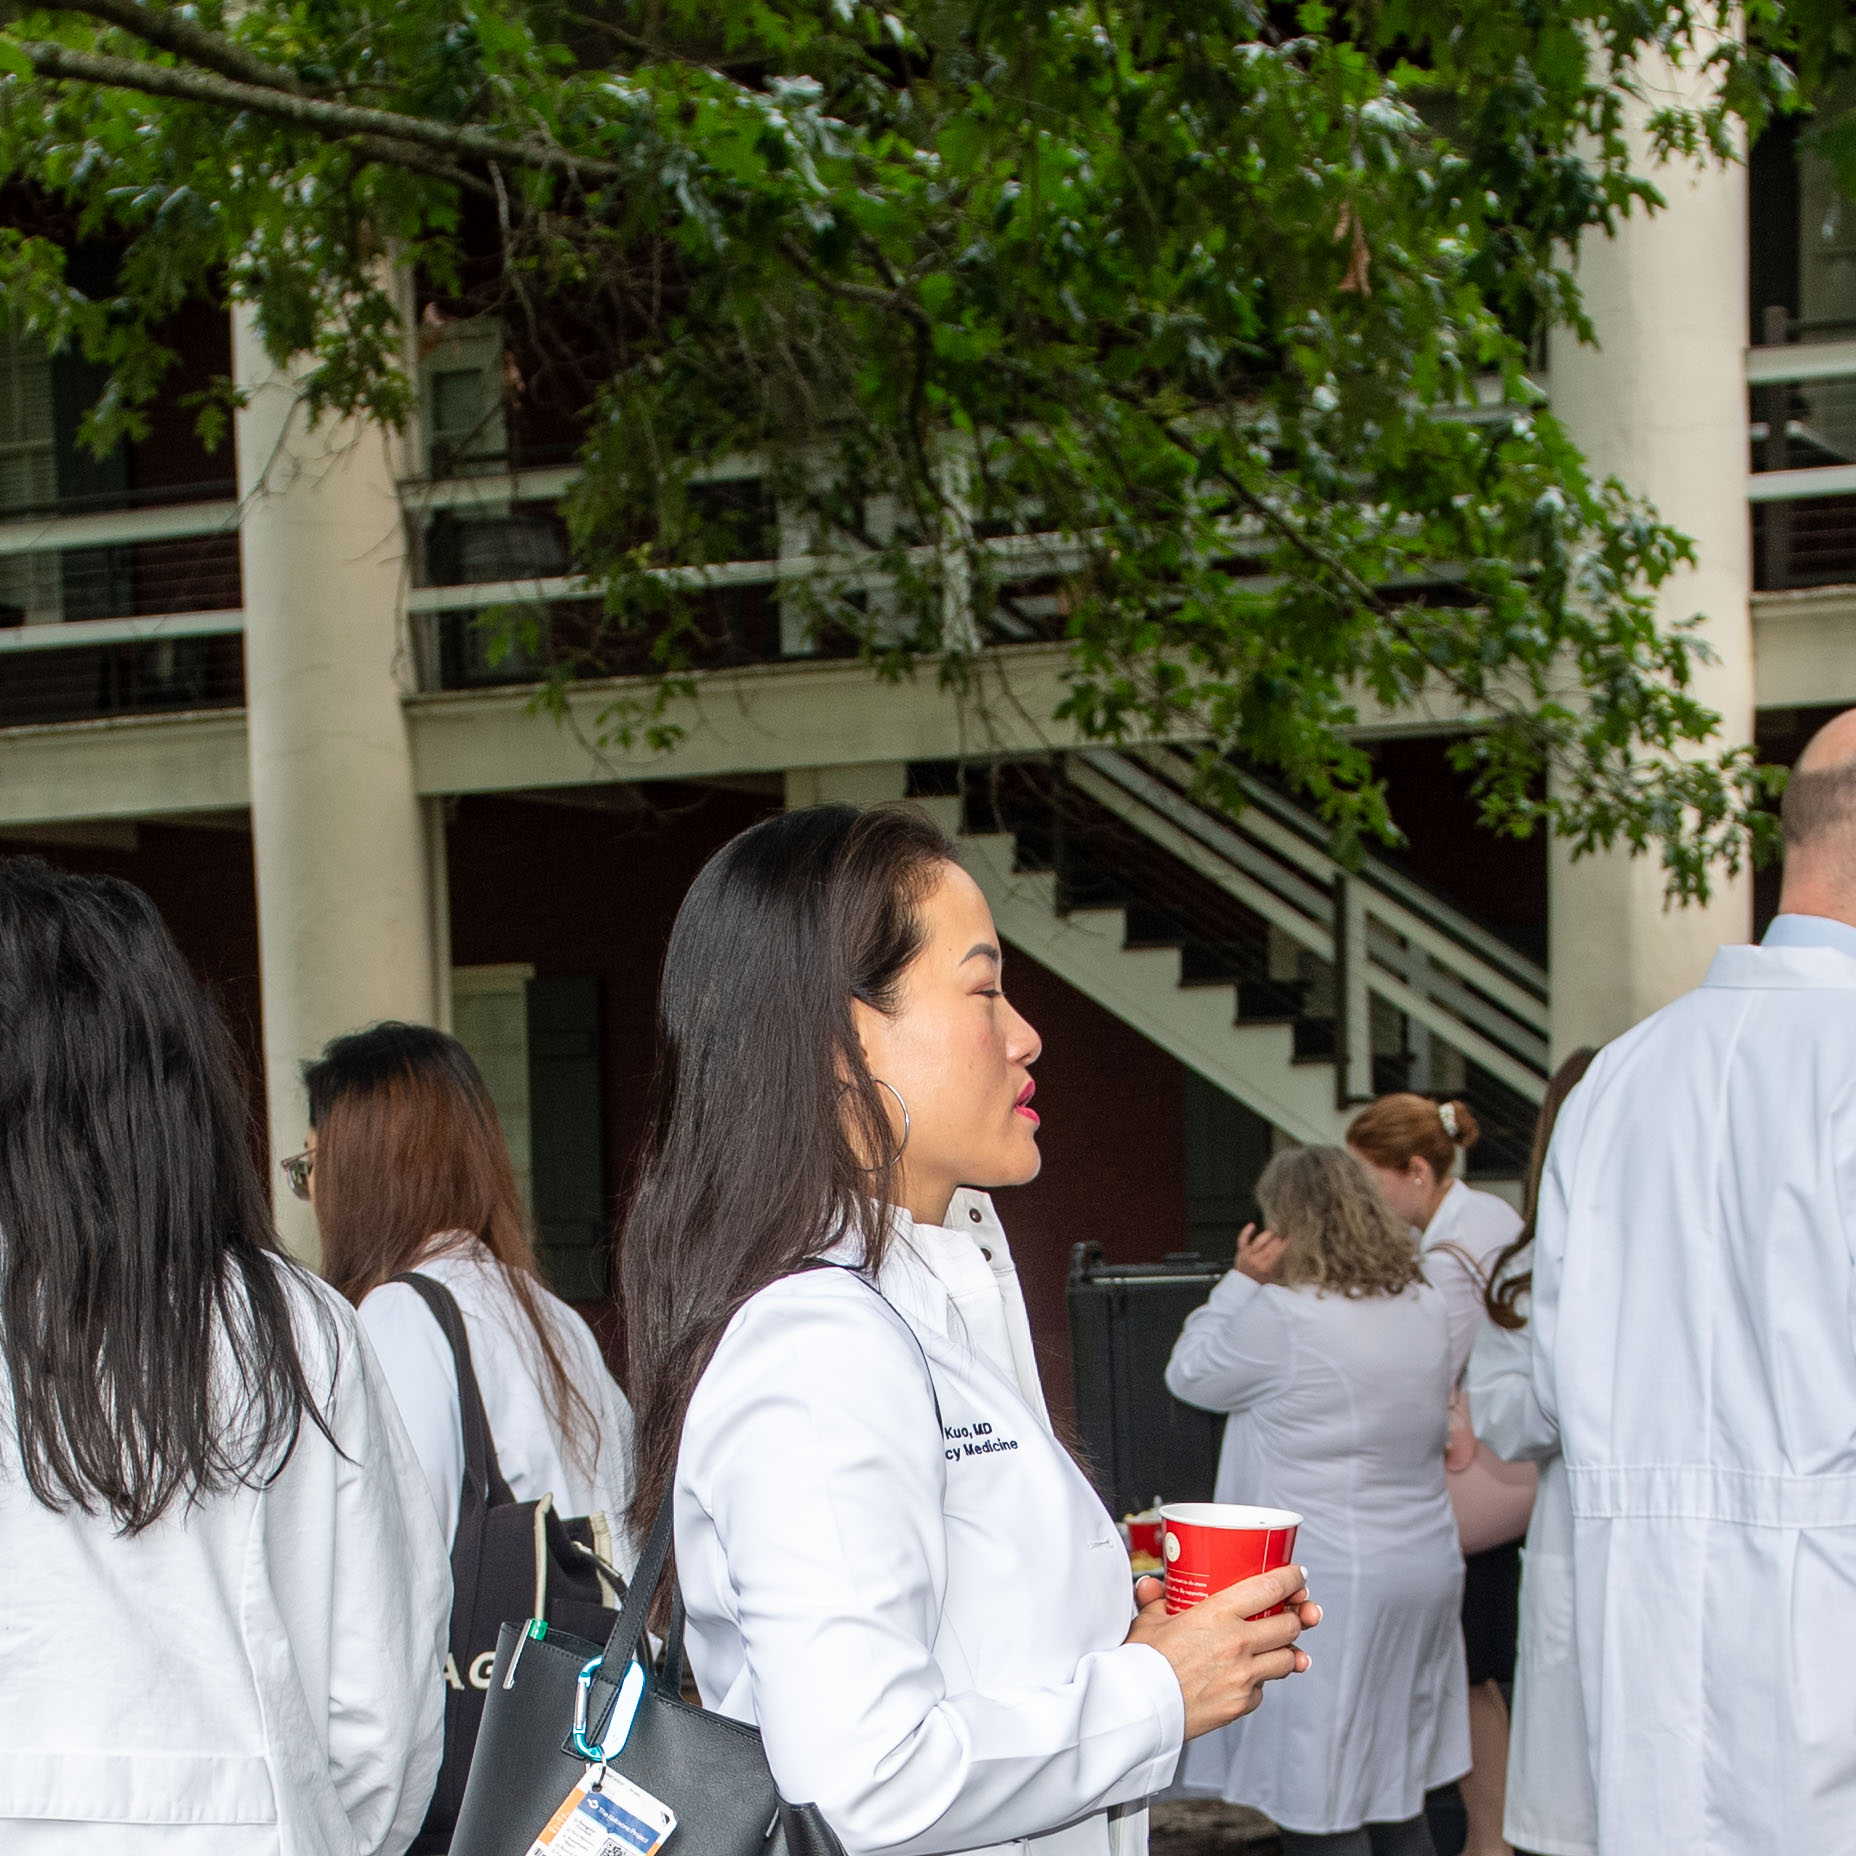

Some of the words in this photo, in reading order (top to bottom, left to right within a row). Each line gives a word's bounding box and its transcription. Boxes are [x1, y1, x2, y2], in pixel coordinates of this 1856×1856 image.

[945, 1426, 973, 1440] Kuo,
[973, 1422, 993, 1436] MD
[963, 1438, 1019, 1456] Medicine
[598, 1806, 609, 1818] The
